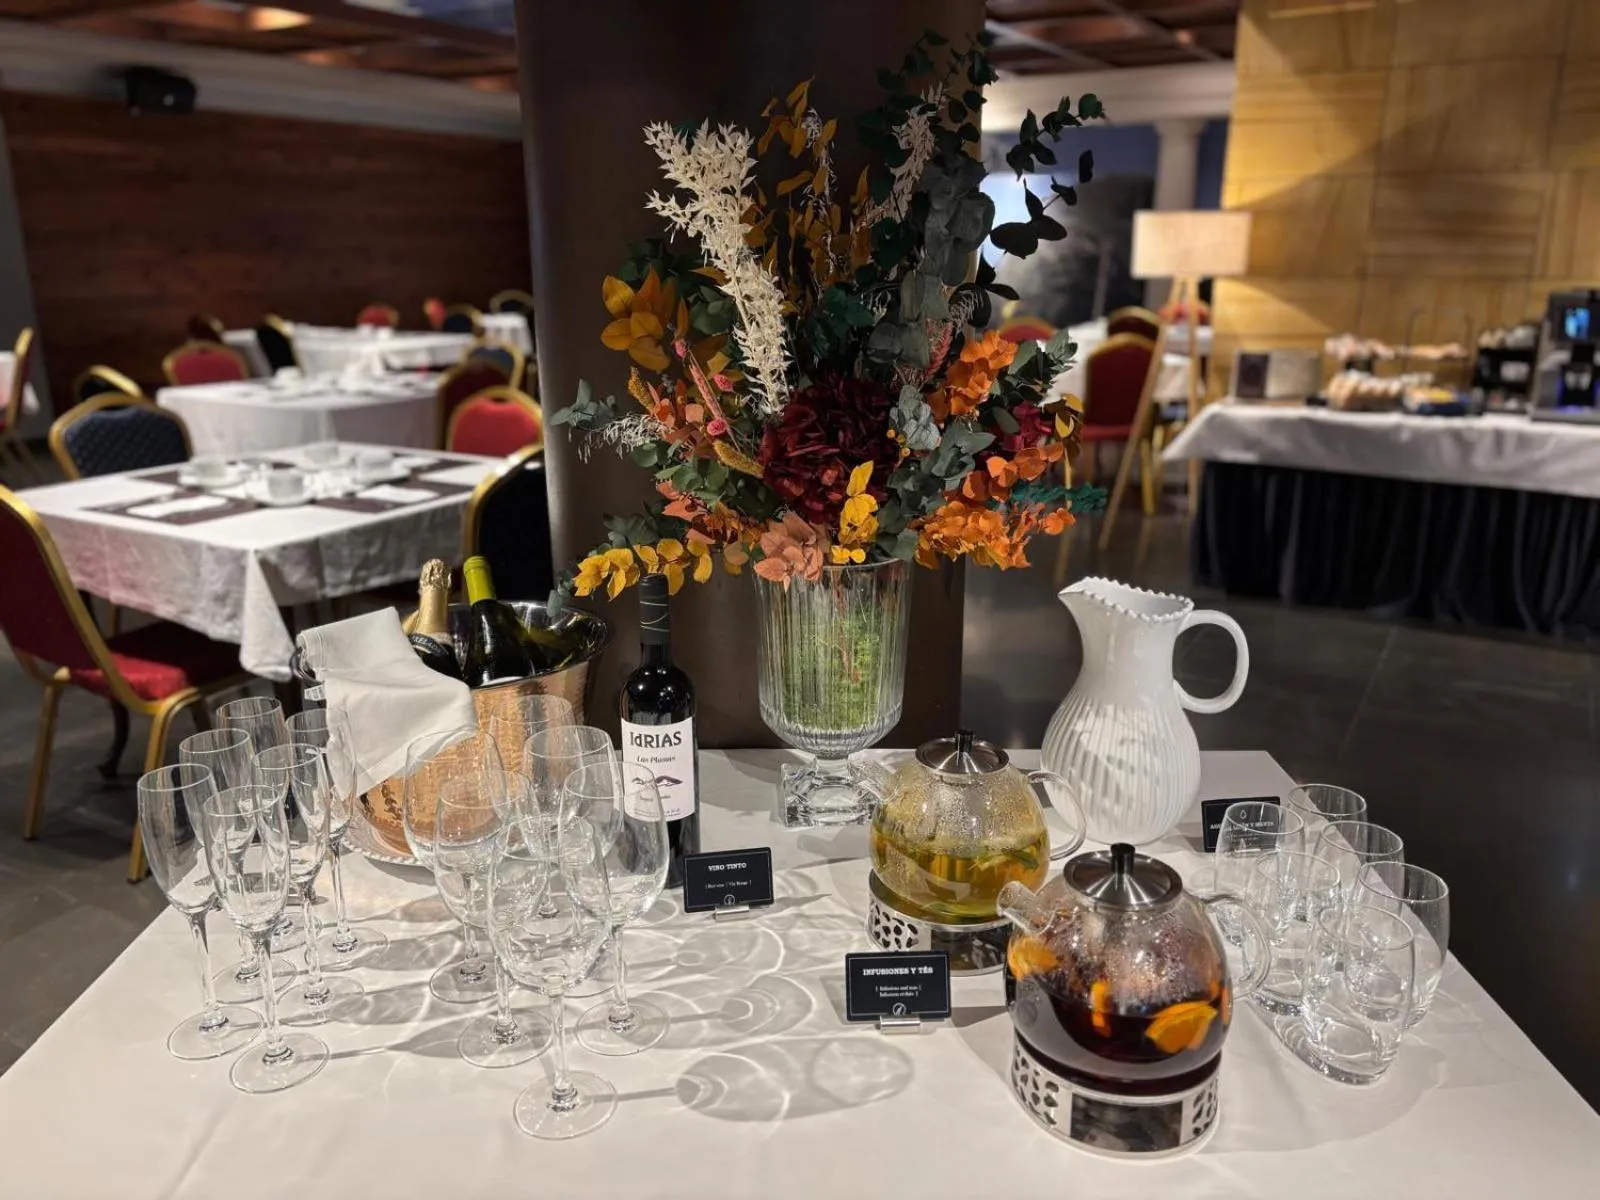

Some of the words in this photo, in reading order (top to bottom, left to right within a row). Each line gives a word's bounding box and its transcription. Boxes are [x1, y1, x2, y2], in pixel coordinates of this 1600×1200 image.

[726, 862, 747, 870] TINTO
[863, 967, 909, 976] INFUSIONES
[918, 965, 934, 974] TÉS
